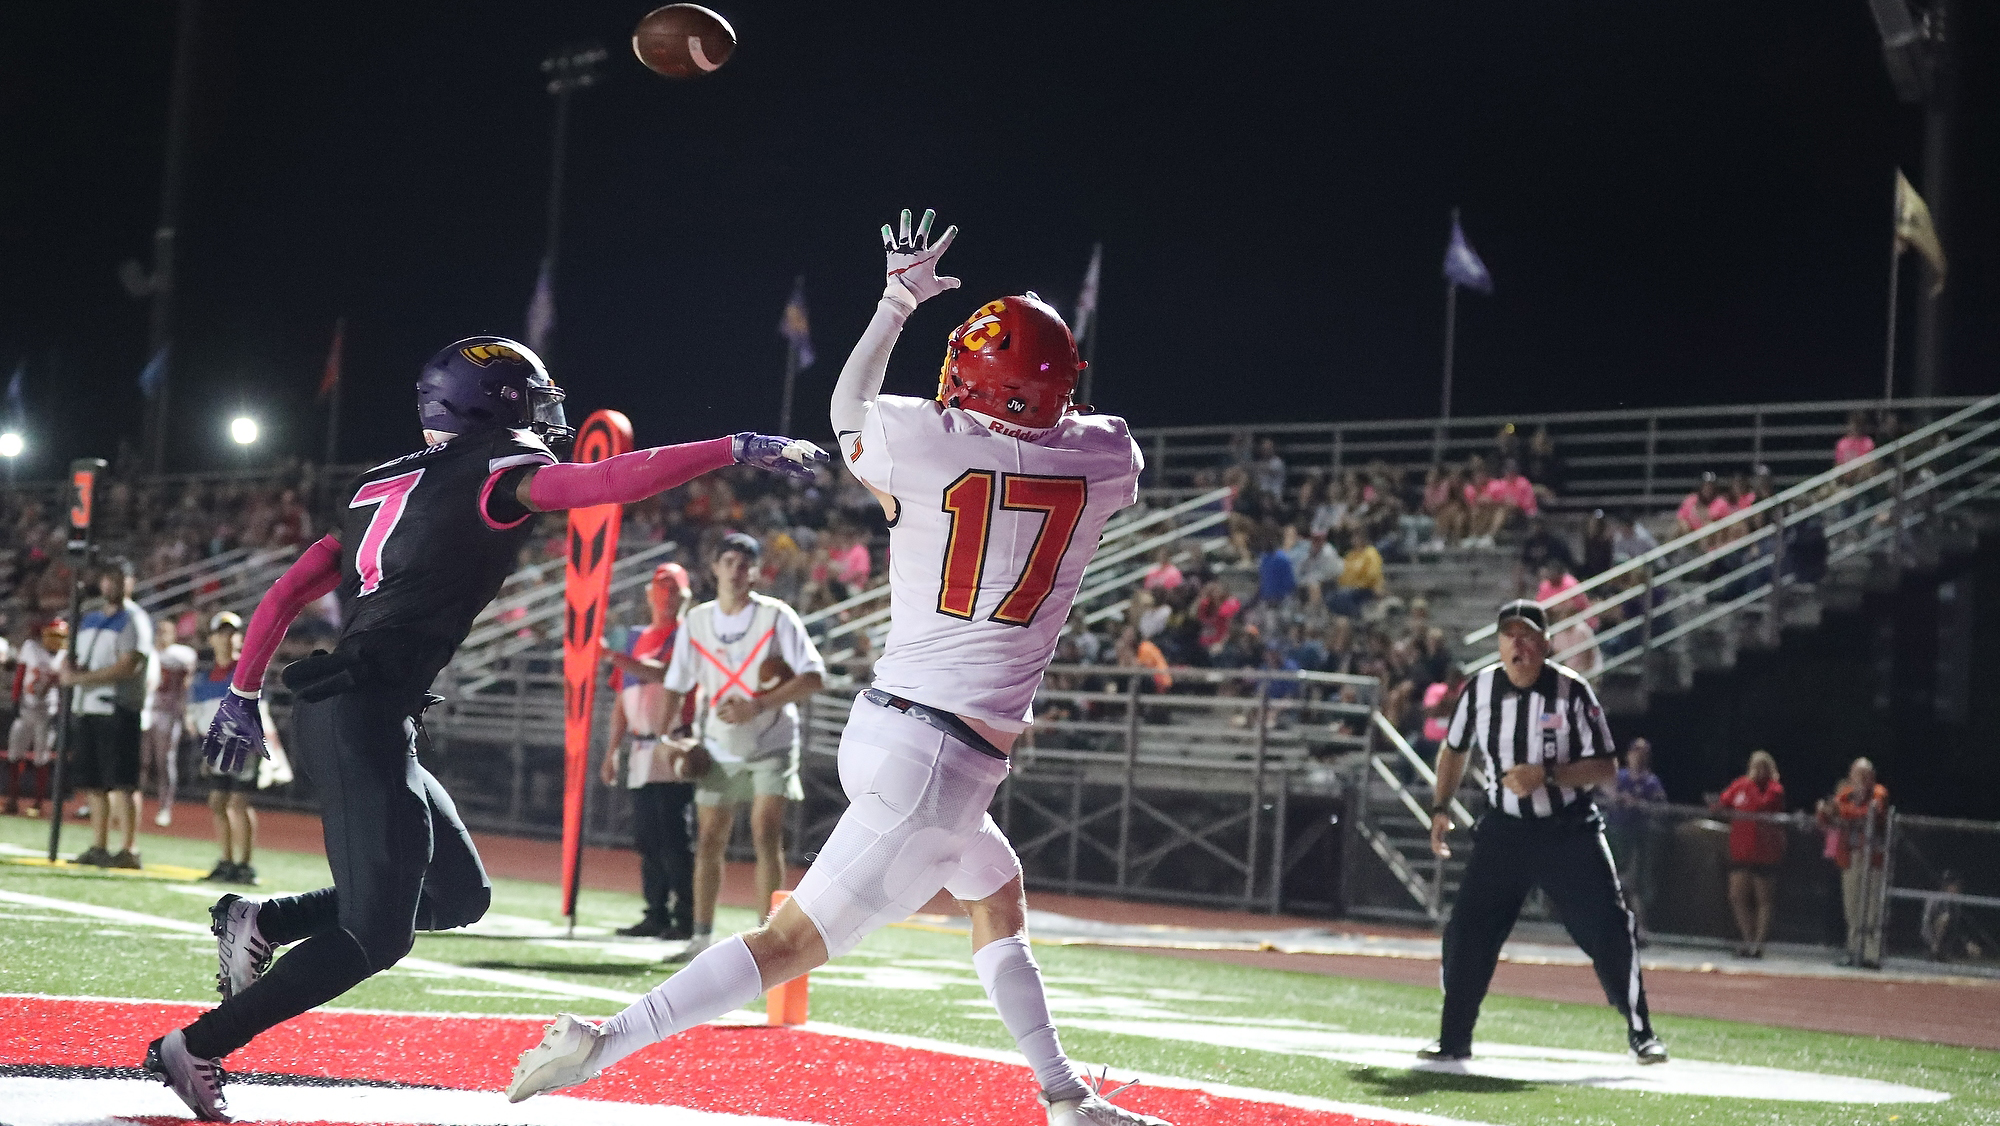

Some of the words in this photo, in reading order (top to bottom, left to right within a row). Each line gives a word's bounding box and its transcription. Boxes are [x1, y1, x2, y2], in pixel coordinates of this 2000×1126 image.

[1007, 400, 1025, 412] JW
[71, 470, 94, 528] 3
[348, 467, 426, 598] 7
[936, 467, 1088, 629] 17
